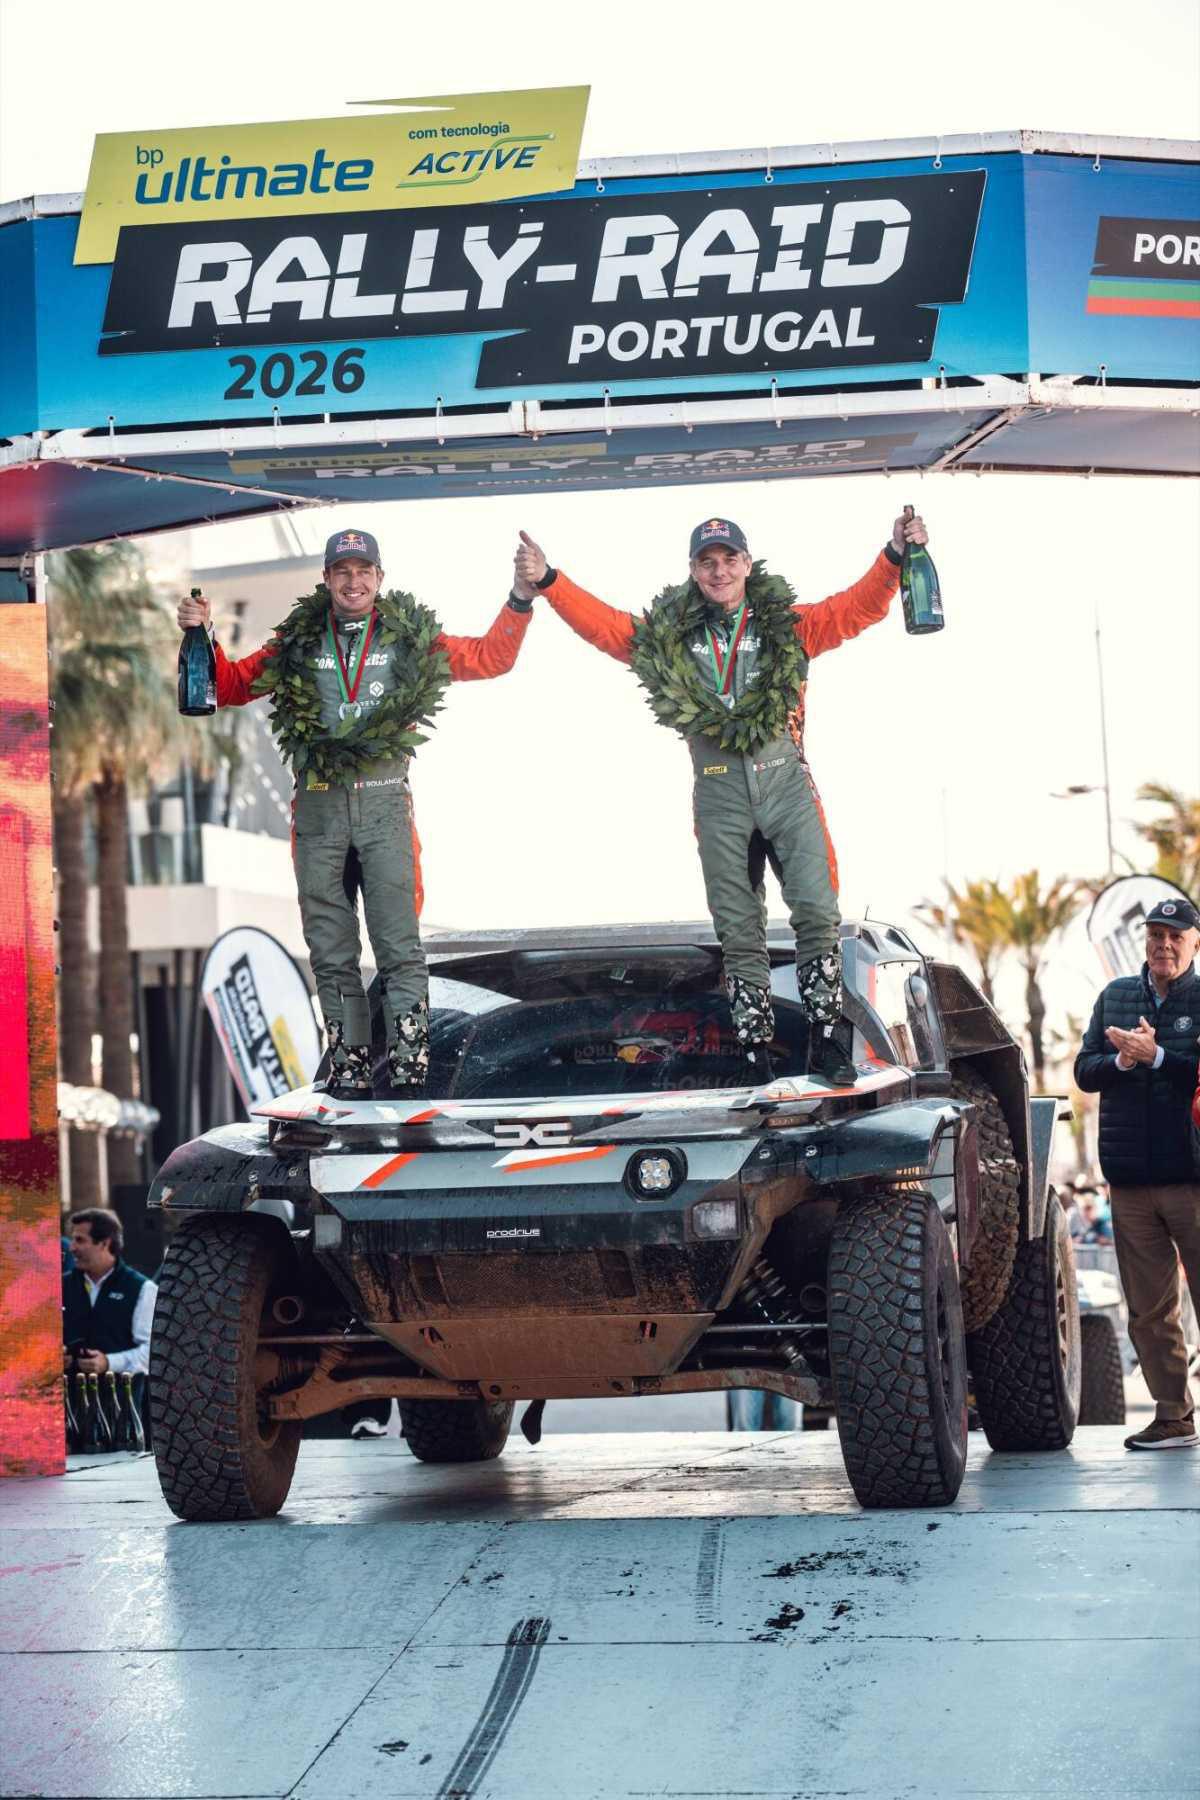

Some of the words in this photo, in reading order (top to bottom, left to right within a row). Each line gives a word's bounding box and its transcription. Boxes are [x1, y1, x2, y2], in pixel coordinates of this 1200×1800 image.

[408, 128, 438, 140] com
[441, 121, 510, 138] tecnologia
[136, 145, 164, 168] bp
[408, 145, 543, 176] ACTIVE
[135, 148, 374, 205] ultimate
[567, 306, 876, 365] PORTUGAL
[224, 348, 366, 400] 2026
[486, 1227, 541, 1239] prodrive
